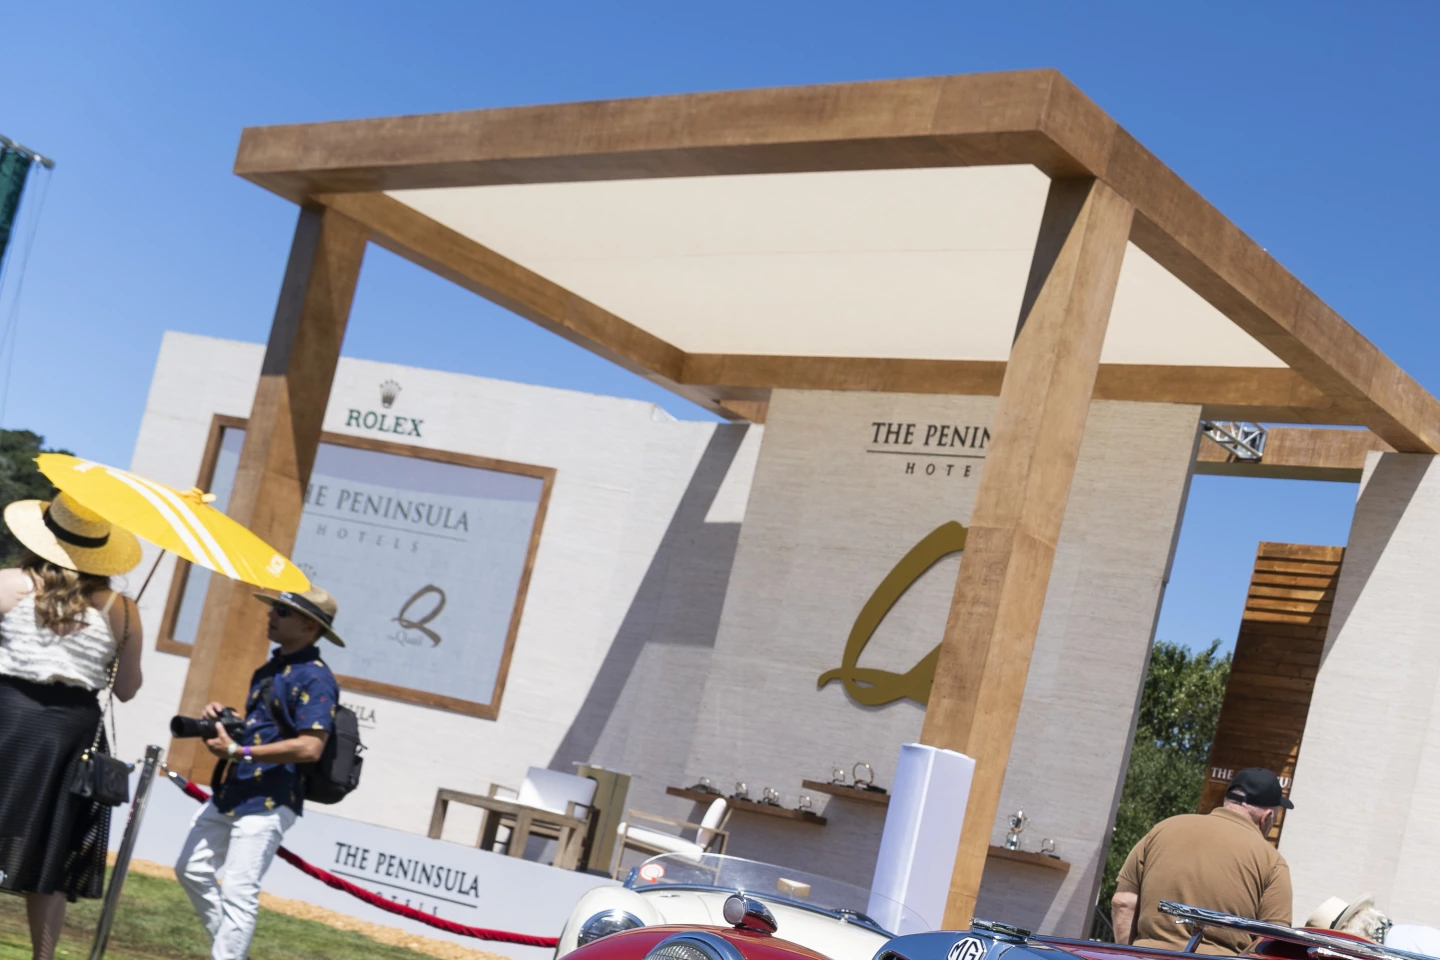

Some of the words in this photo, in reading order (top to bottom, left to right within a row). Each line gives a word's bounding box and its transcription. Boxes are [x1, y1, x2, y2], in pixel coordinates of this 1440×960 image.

[345, 408, 425, 438] ROLEX
[871, 421, 916, 445] THE
[923, 424, 991, 449] PENIN
[905, 461, 972, 478] HOTE
[336, 488, 469, 533] PENINSULA
[315, 523, 419, 553] HOTELS
[1211, 766, 1234, 780] THE
[334, 841, 371, 871] THE
[374, 852, 480, 899] PENINSULA
